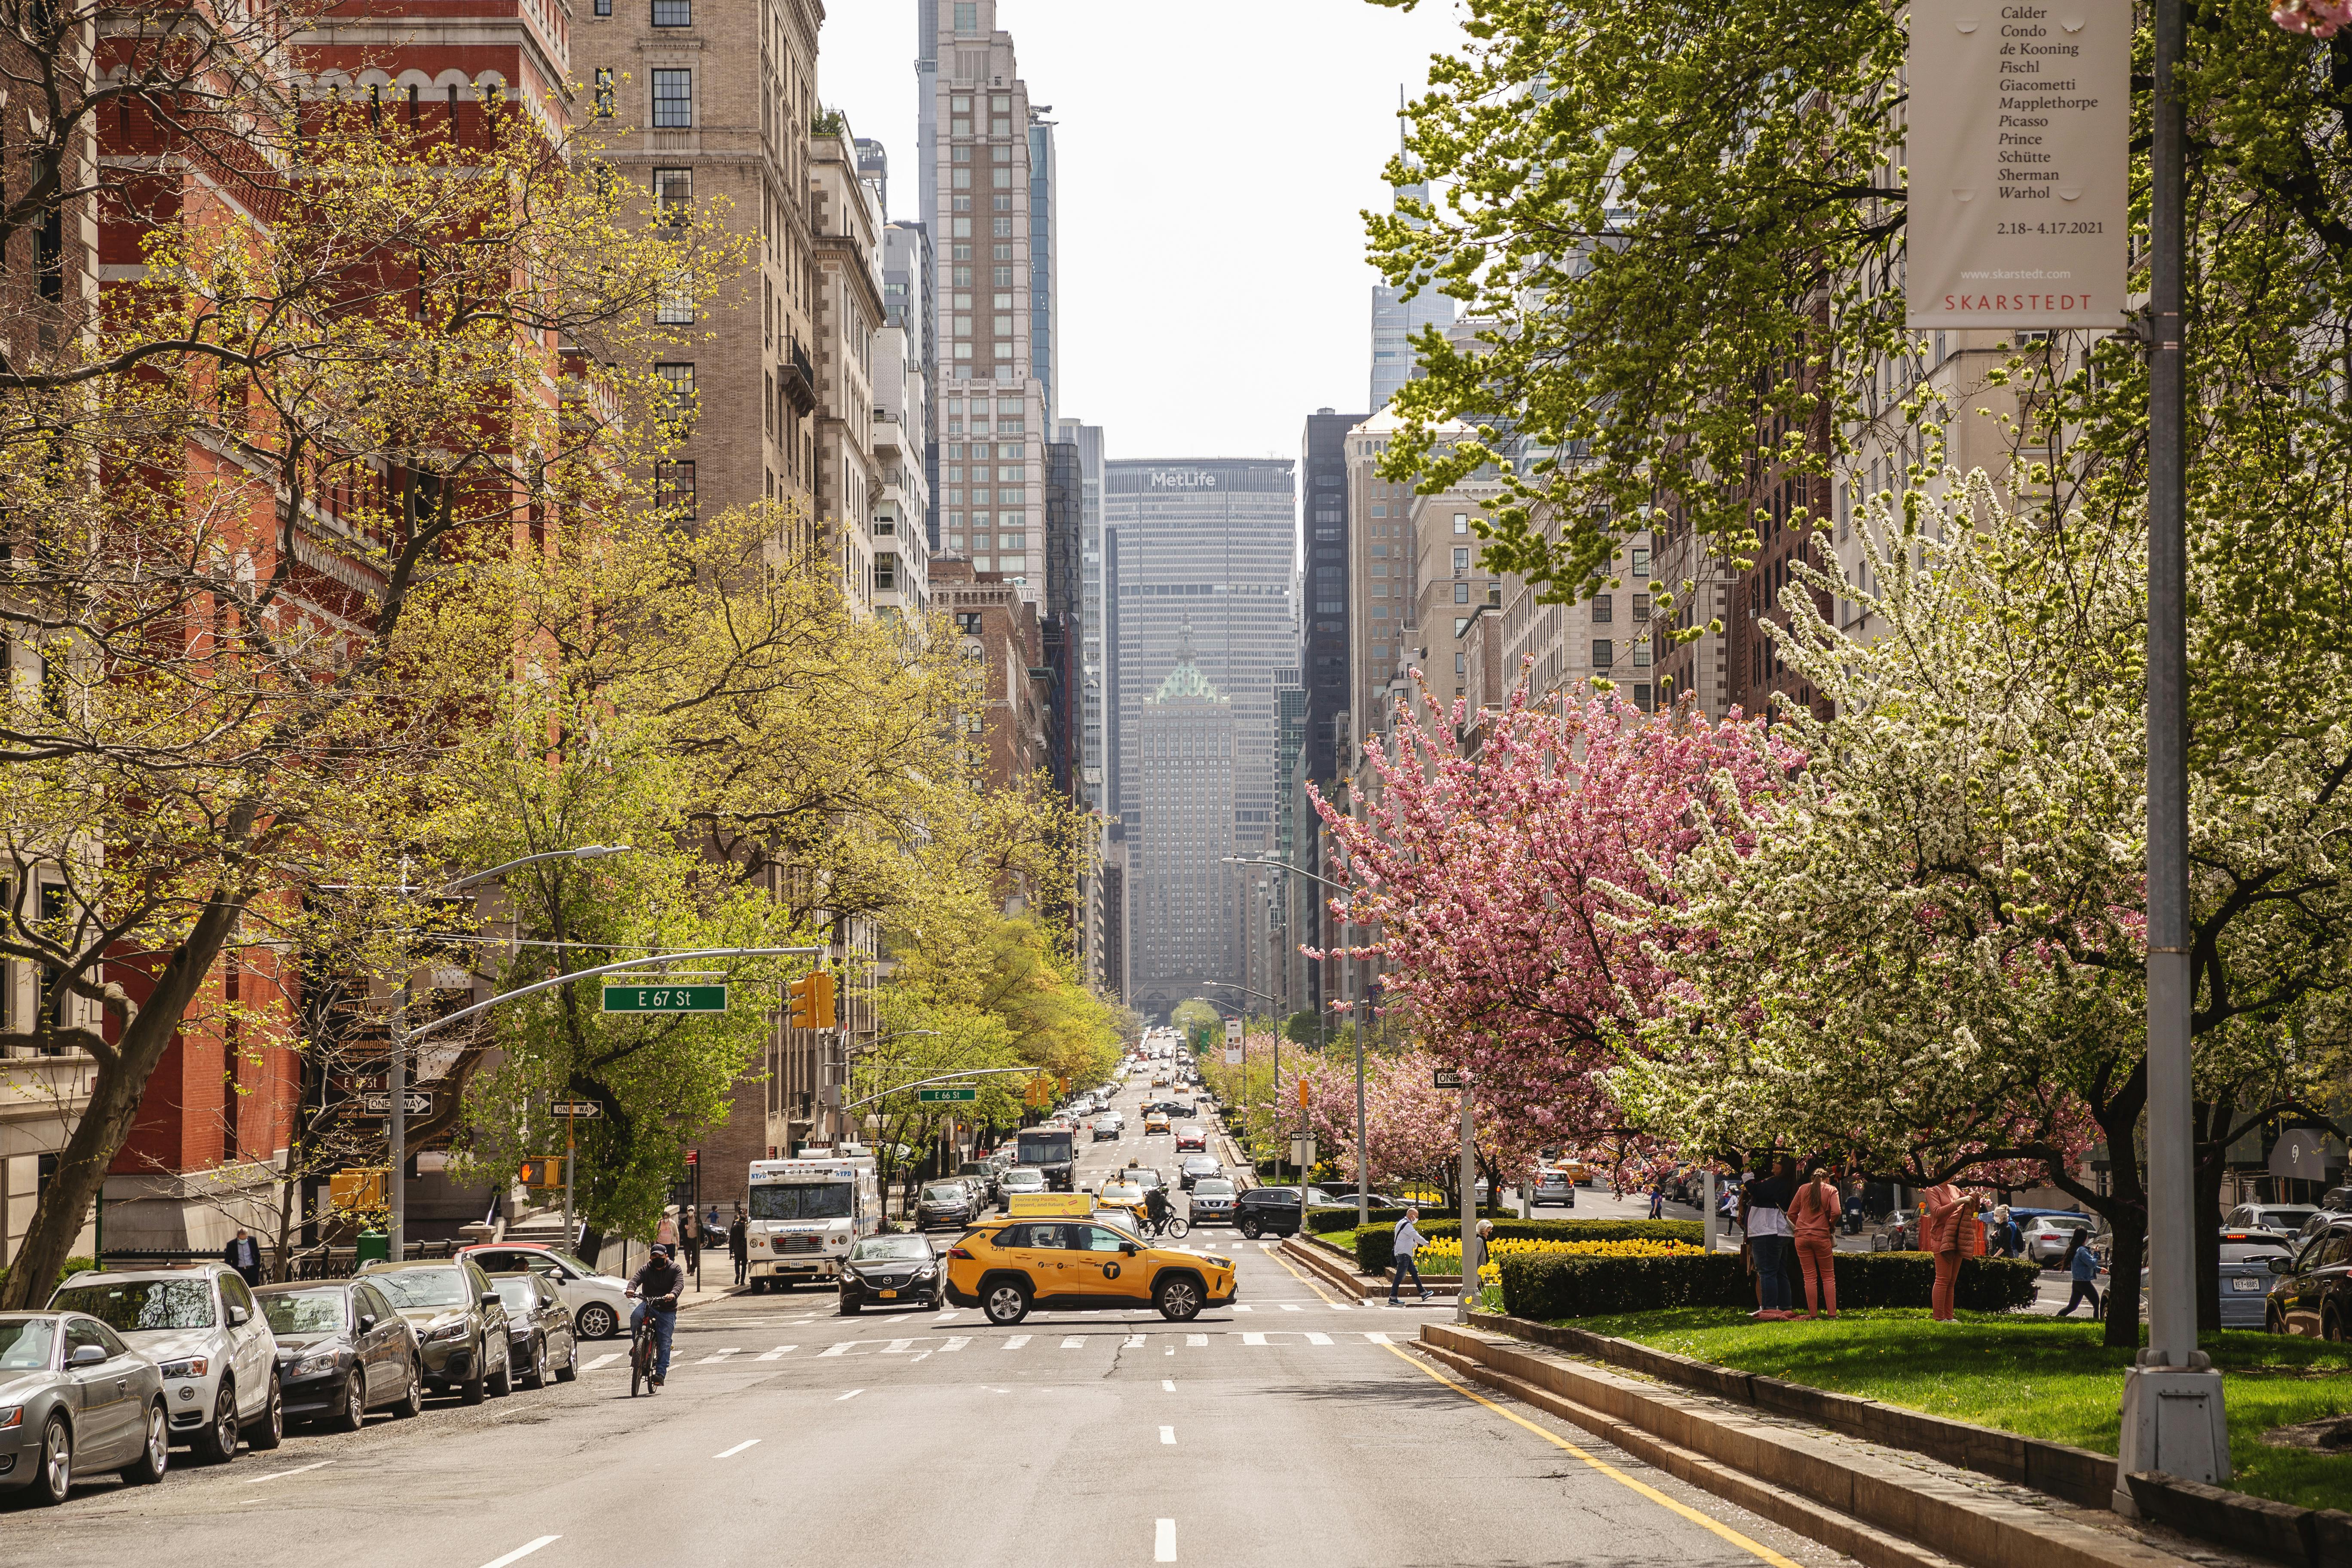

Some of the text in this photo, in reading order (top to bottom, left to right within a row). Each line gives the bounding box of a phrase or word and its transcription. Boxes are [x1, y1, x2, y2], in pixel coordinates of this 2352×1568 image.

[2001, 6, 2047, 19] Calder
[2001, 24, 2046, 37] Condo
[2000, 43, 2079, 57] de Kooning
[1999, 61, 2040, 73] Fischl
[2000, 79, 2076, 91] Giacometti
[1999, 96, 2098, 111] Mapplethorpe
[1999, 116, 2048, 127] Picasso
[1998, 133, 2042, 145] Prince
[1998, 151, 2051, 163] Schütte
[1997, 168, 2059, 181] Sherman
[1999, 187, 2050, 199] Warhol
[1960, 269, 2071, 279] www.skarstedt.com
[1945, 295, 2092, 310] SKARSTEDT
[1152, 472, 1215, 486] MetLife
[639, 991, 691, 1006] E 67 St
[338, 1040, 391, 1049] AFTERWARDSNE
[371, 1100, 390, 1108] ONE
